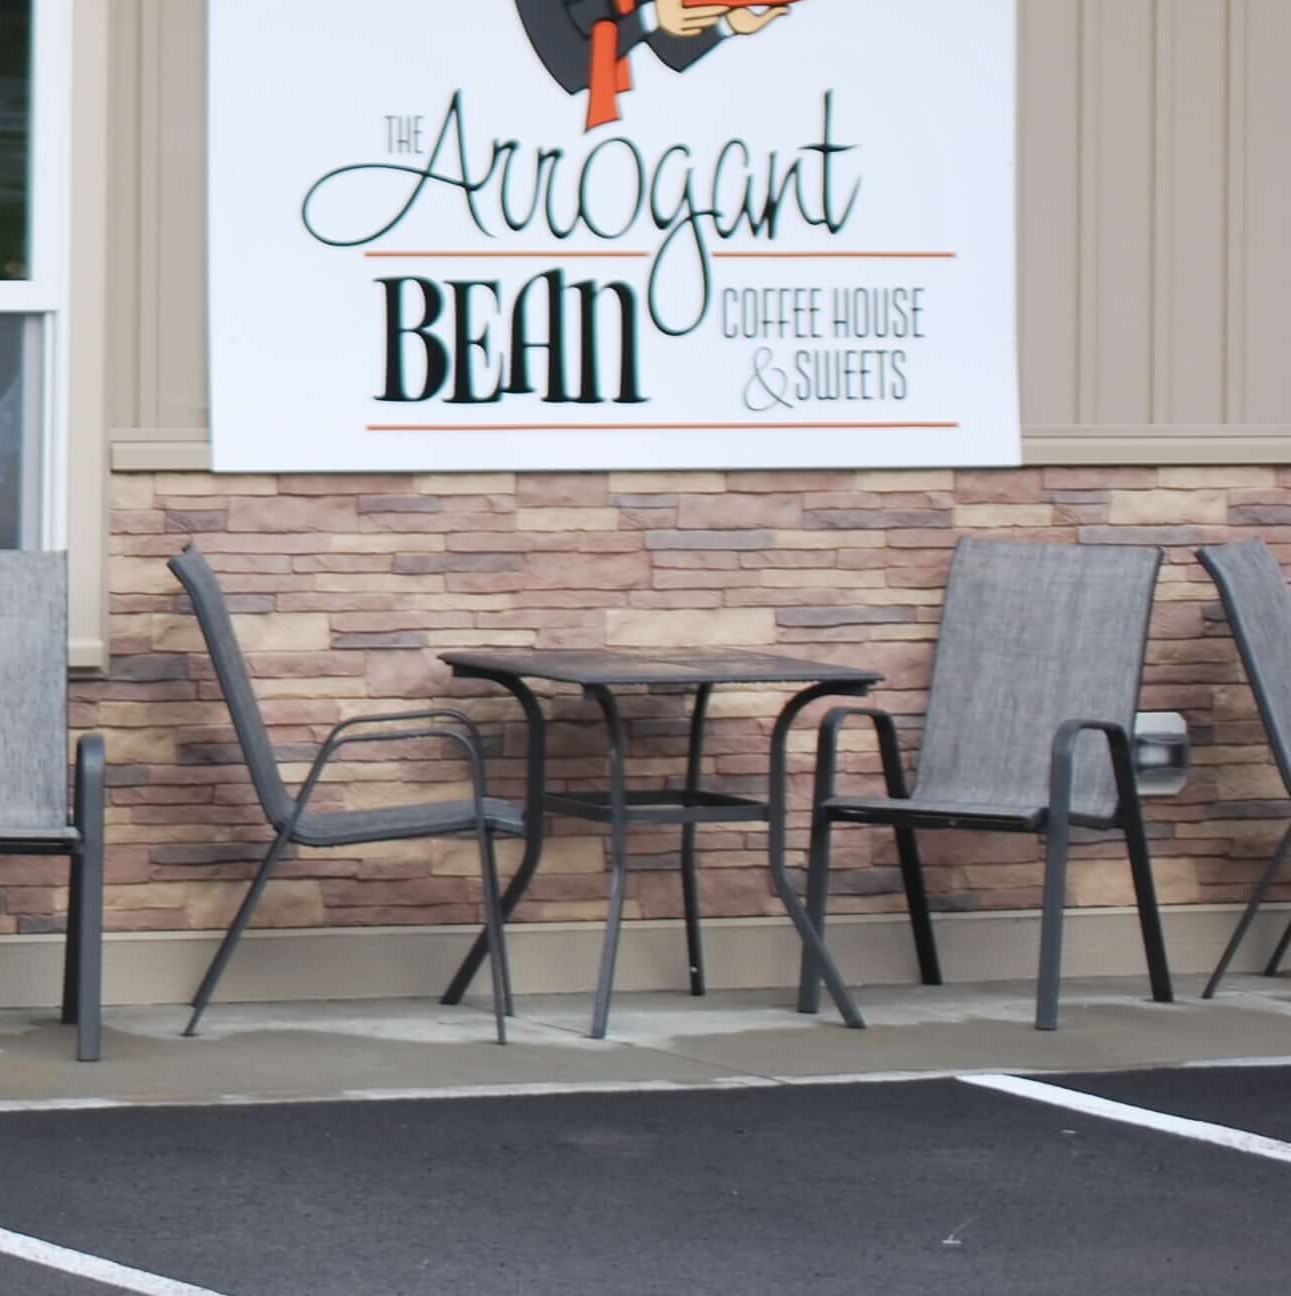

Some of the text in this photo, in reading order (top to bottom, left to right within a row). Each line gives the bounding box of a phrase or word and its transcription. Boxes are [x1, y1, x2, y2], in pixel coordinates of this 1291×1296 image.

[383, 114, 426, 155] THE
[301, 88, 863, 336] Arrogant
[372, 267, 652, 405] BEAN
[721, 287, 926, 339] COFFEE HOUSE
[743, 346, 908, 412] & SWEETS
